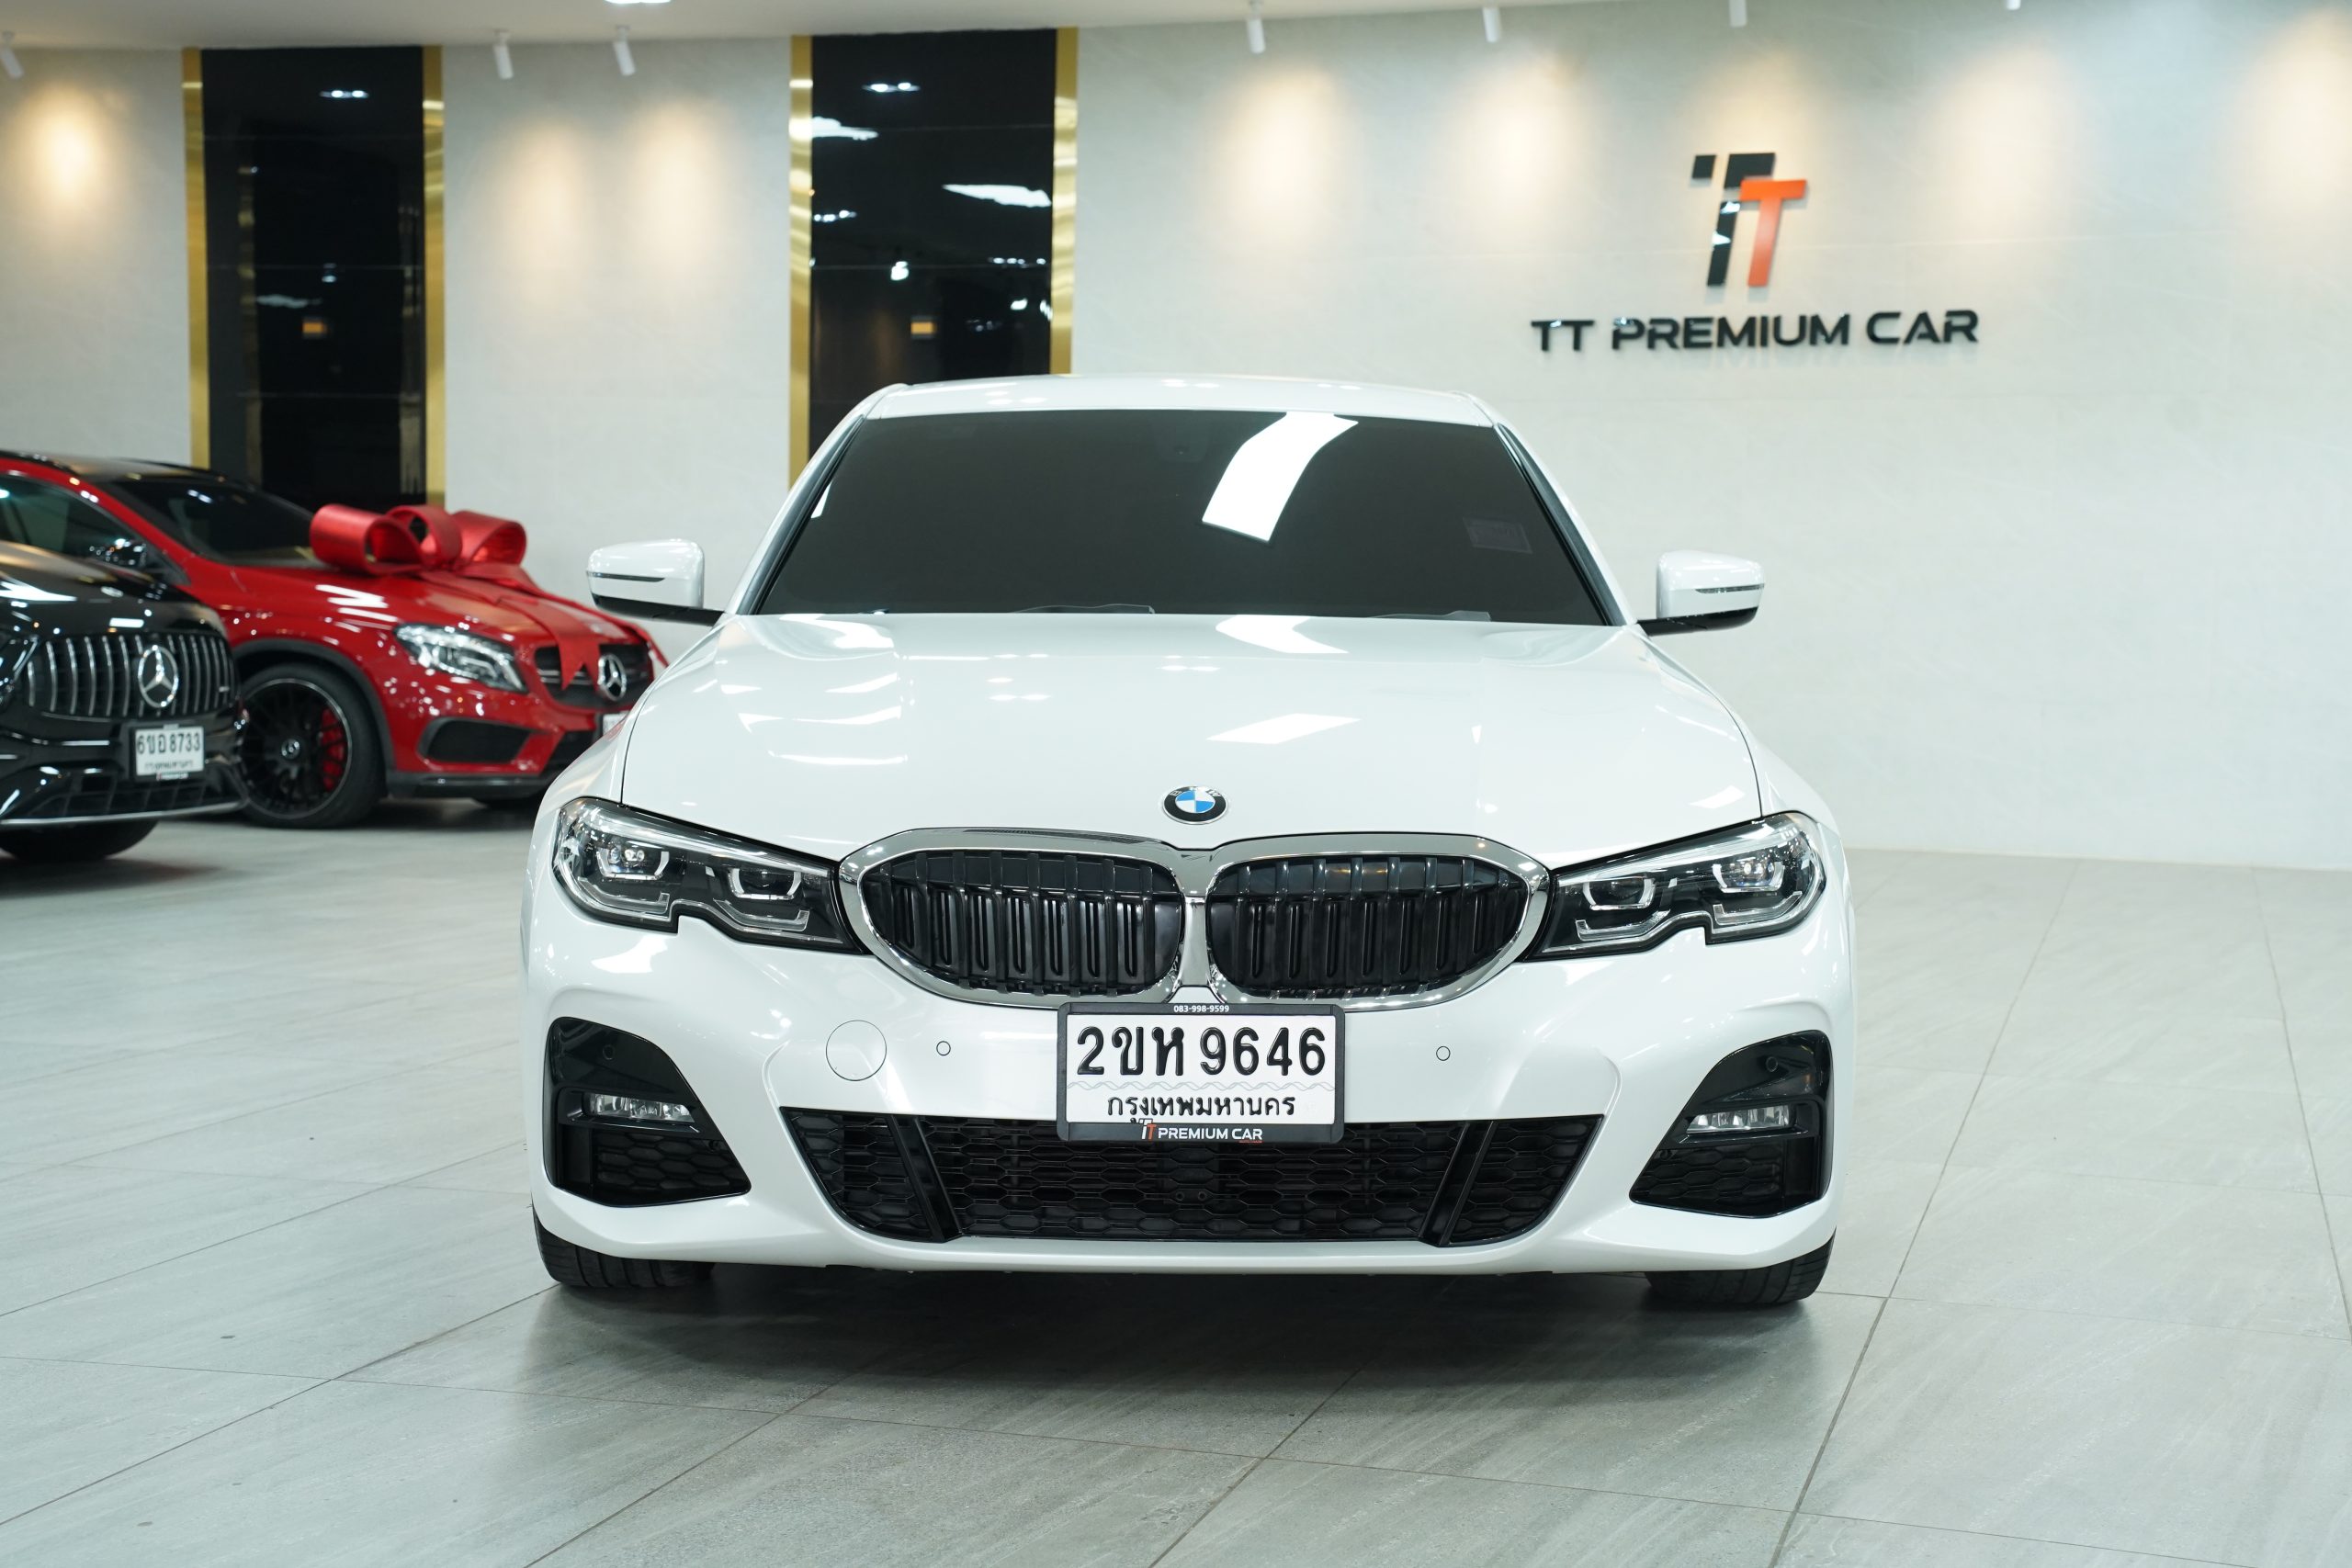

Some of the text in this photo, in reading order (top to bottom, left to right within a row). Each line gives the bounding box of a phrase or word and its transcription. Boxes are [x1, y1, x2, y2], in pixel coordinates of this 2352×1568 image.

[1531, 310, 1979, 352] TT PREMIUM CAR
[169, 732, 200, 753] 8733
[1173, 1004, 1230, 1013] 083-998-9599
[1077, 1026, 1326, 1077] 2ขห 9646
[1158, 1127, 1228, 1140] PREMIUM
[1231, 1128, 1263, 1141] CAR
